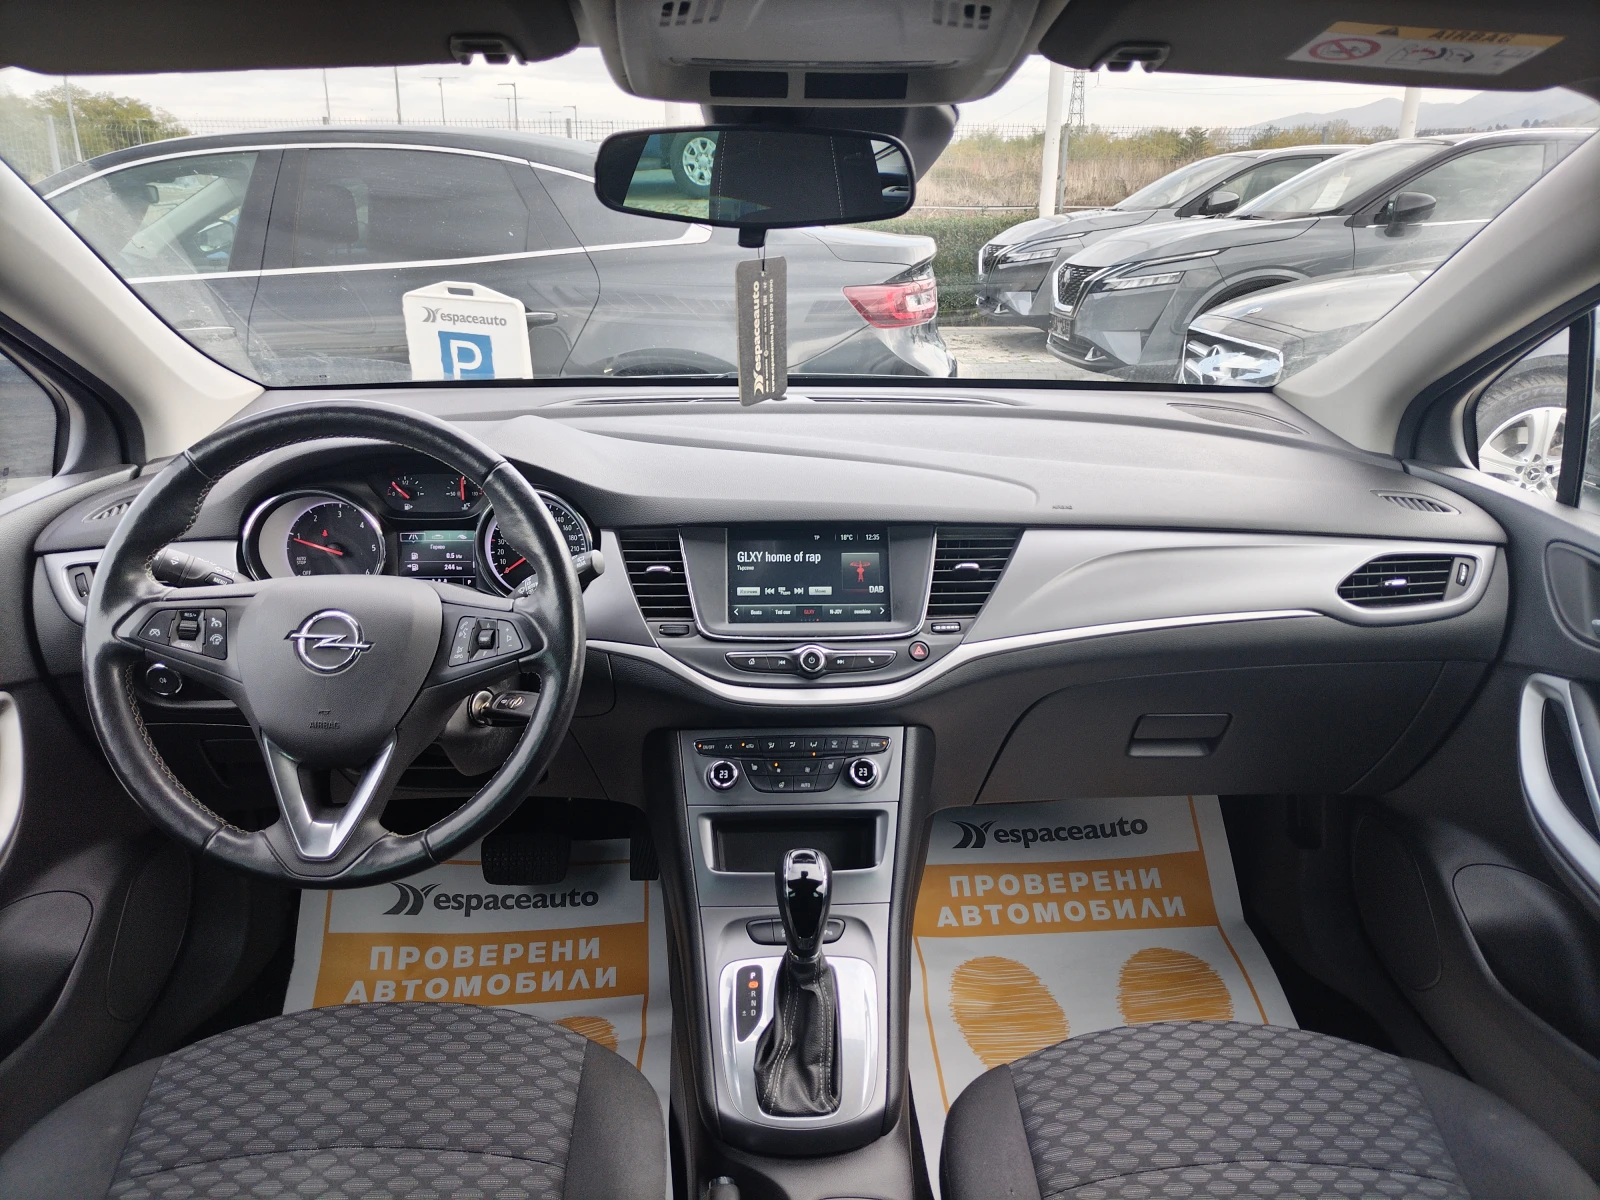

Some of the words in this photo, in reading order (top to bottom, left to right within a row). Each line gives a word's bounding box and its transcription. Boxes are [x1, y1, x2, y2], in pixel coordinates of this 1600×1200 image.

[1428, 28, 1517, 44] AIRBAG
[440, 312, 507, 326] espaceauto
[753, 281, 762, 372] espaceauto
[449, 339, 482, 380] P
[737, 552, 762, 562] GLXY
[765, 552, 791, 562] home
[794, 551, 803, 562] of
[806, 553, 821, 564] rap
[310, 722, 340, 730] AIRBAG
[719, 770, 728, 778] 23
[859, 768, 868, 776] 23
[994, 816, 1148, 848] espaceauto
[949, 867, 1162, 898] ПРОВЕРЕНИ
[433, 888, 599, 917] espaceauto
[937, 896, 1186, 928] АВТОМОБИЛИ
[369, 937, 600, 971] ПРОВЕРЕНИ
[343, 966, 617, 1004] АВТОМОБИЛИ
